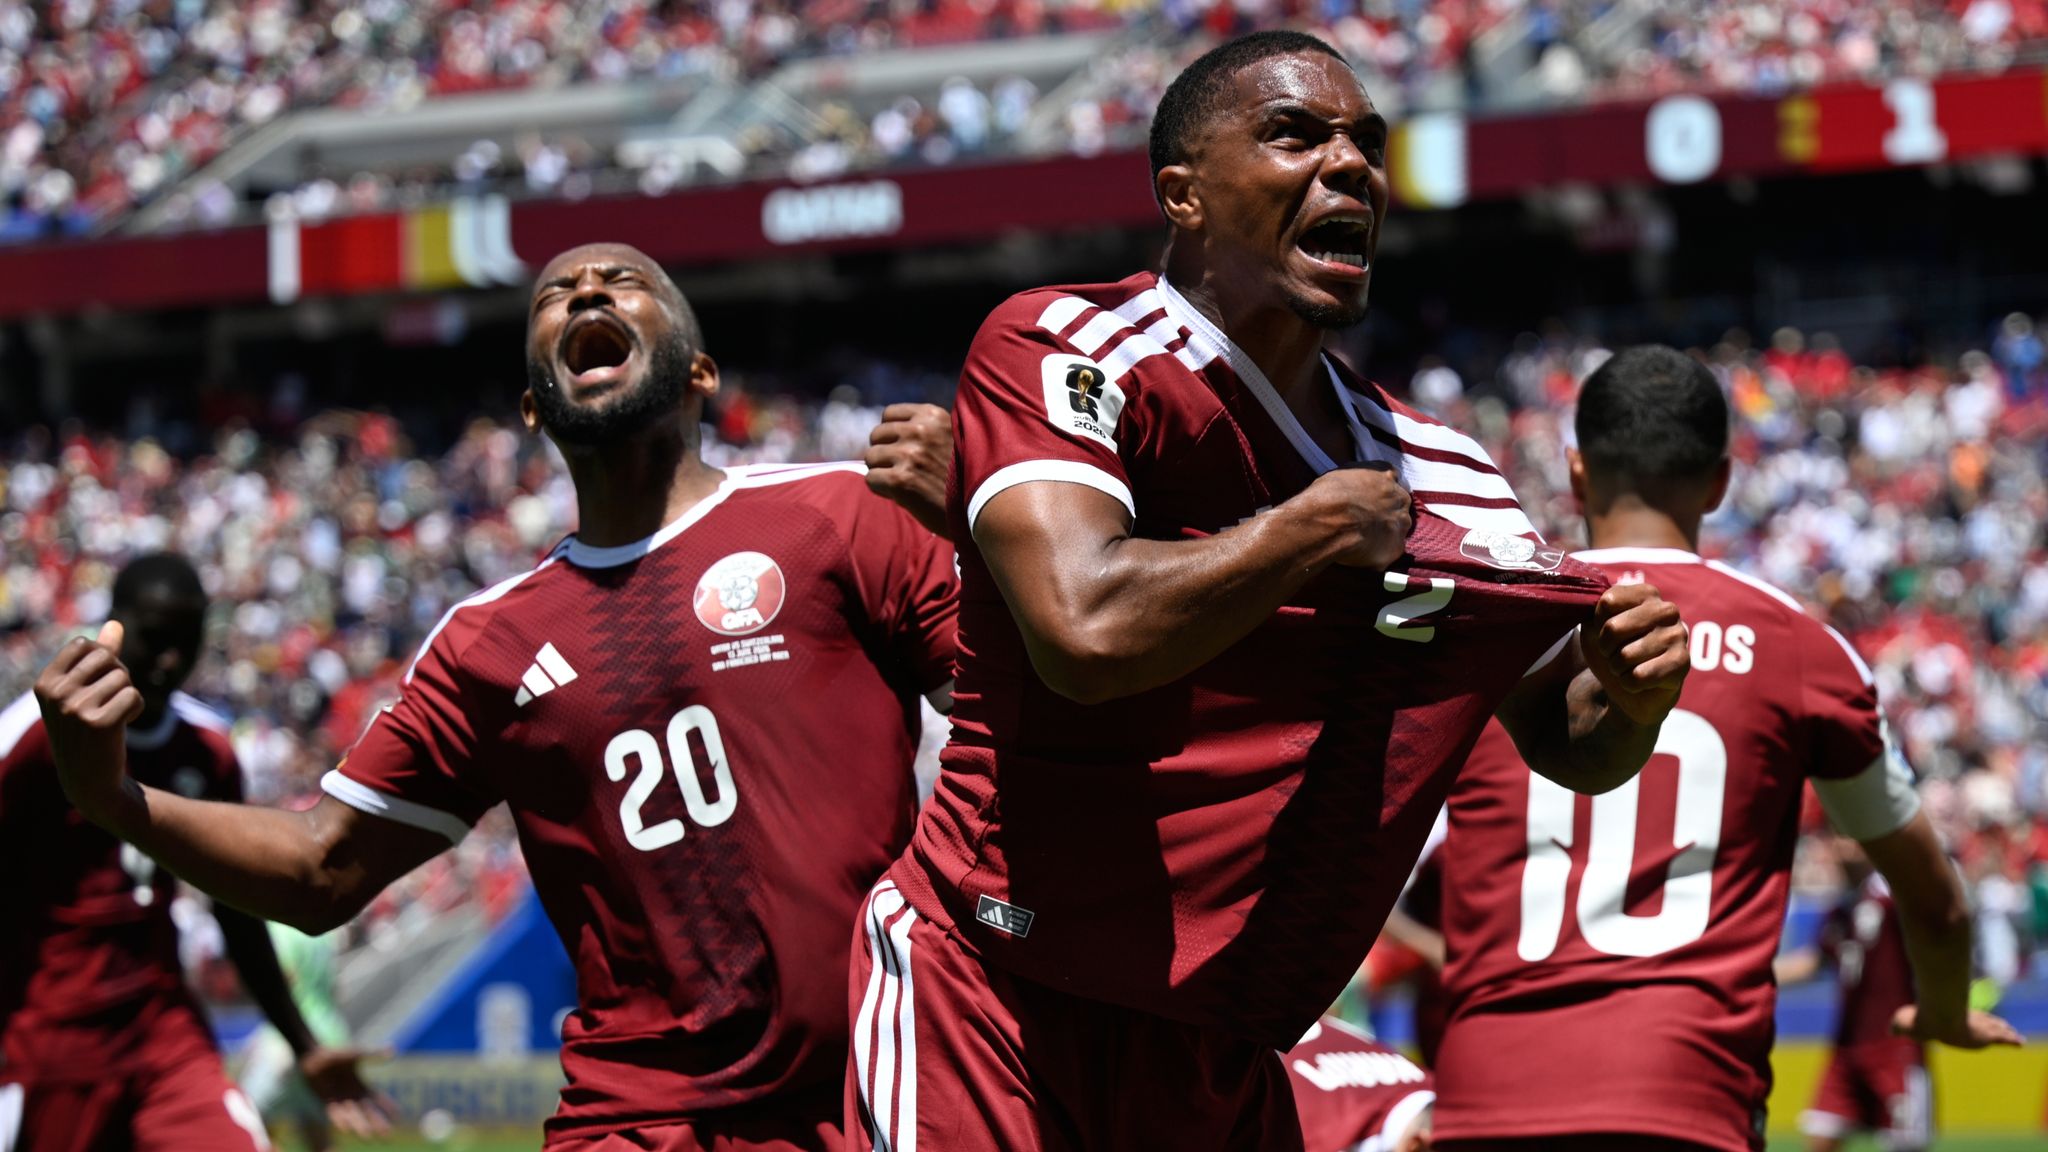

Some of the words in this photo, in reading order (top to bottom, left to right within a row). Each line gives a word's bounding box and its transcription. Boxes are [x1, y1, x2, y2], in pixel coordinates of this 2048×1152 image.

[1881, 79, 1948, 165] 1
[761, 179, 904, 245] QATAR
[1074, 420, 1107, 439] 2026
[1374, 571, 1455, 643] 2
[604, 704, 738, 851] 20
[1517, 707, 1727, 963] 10
